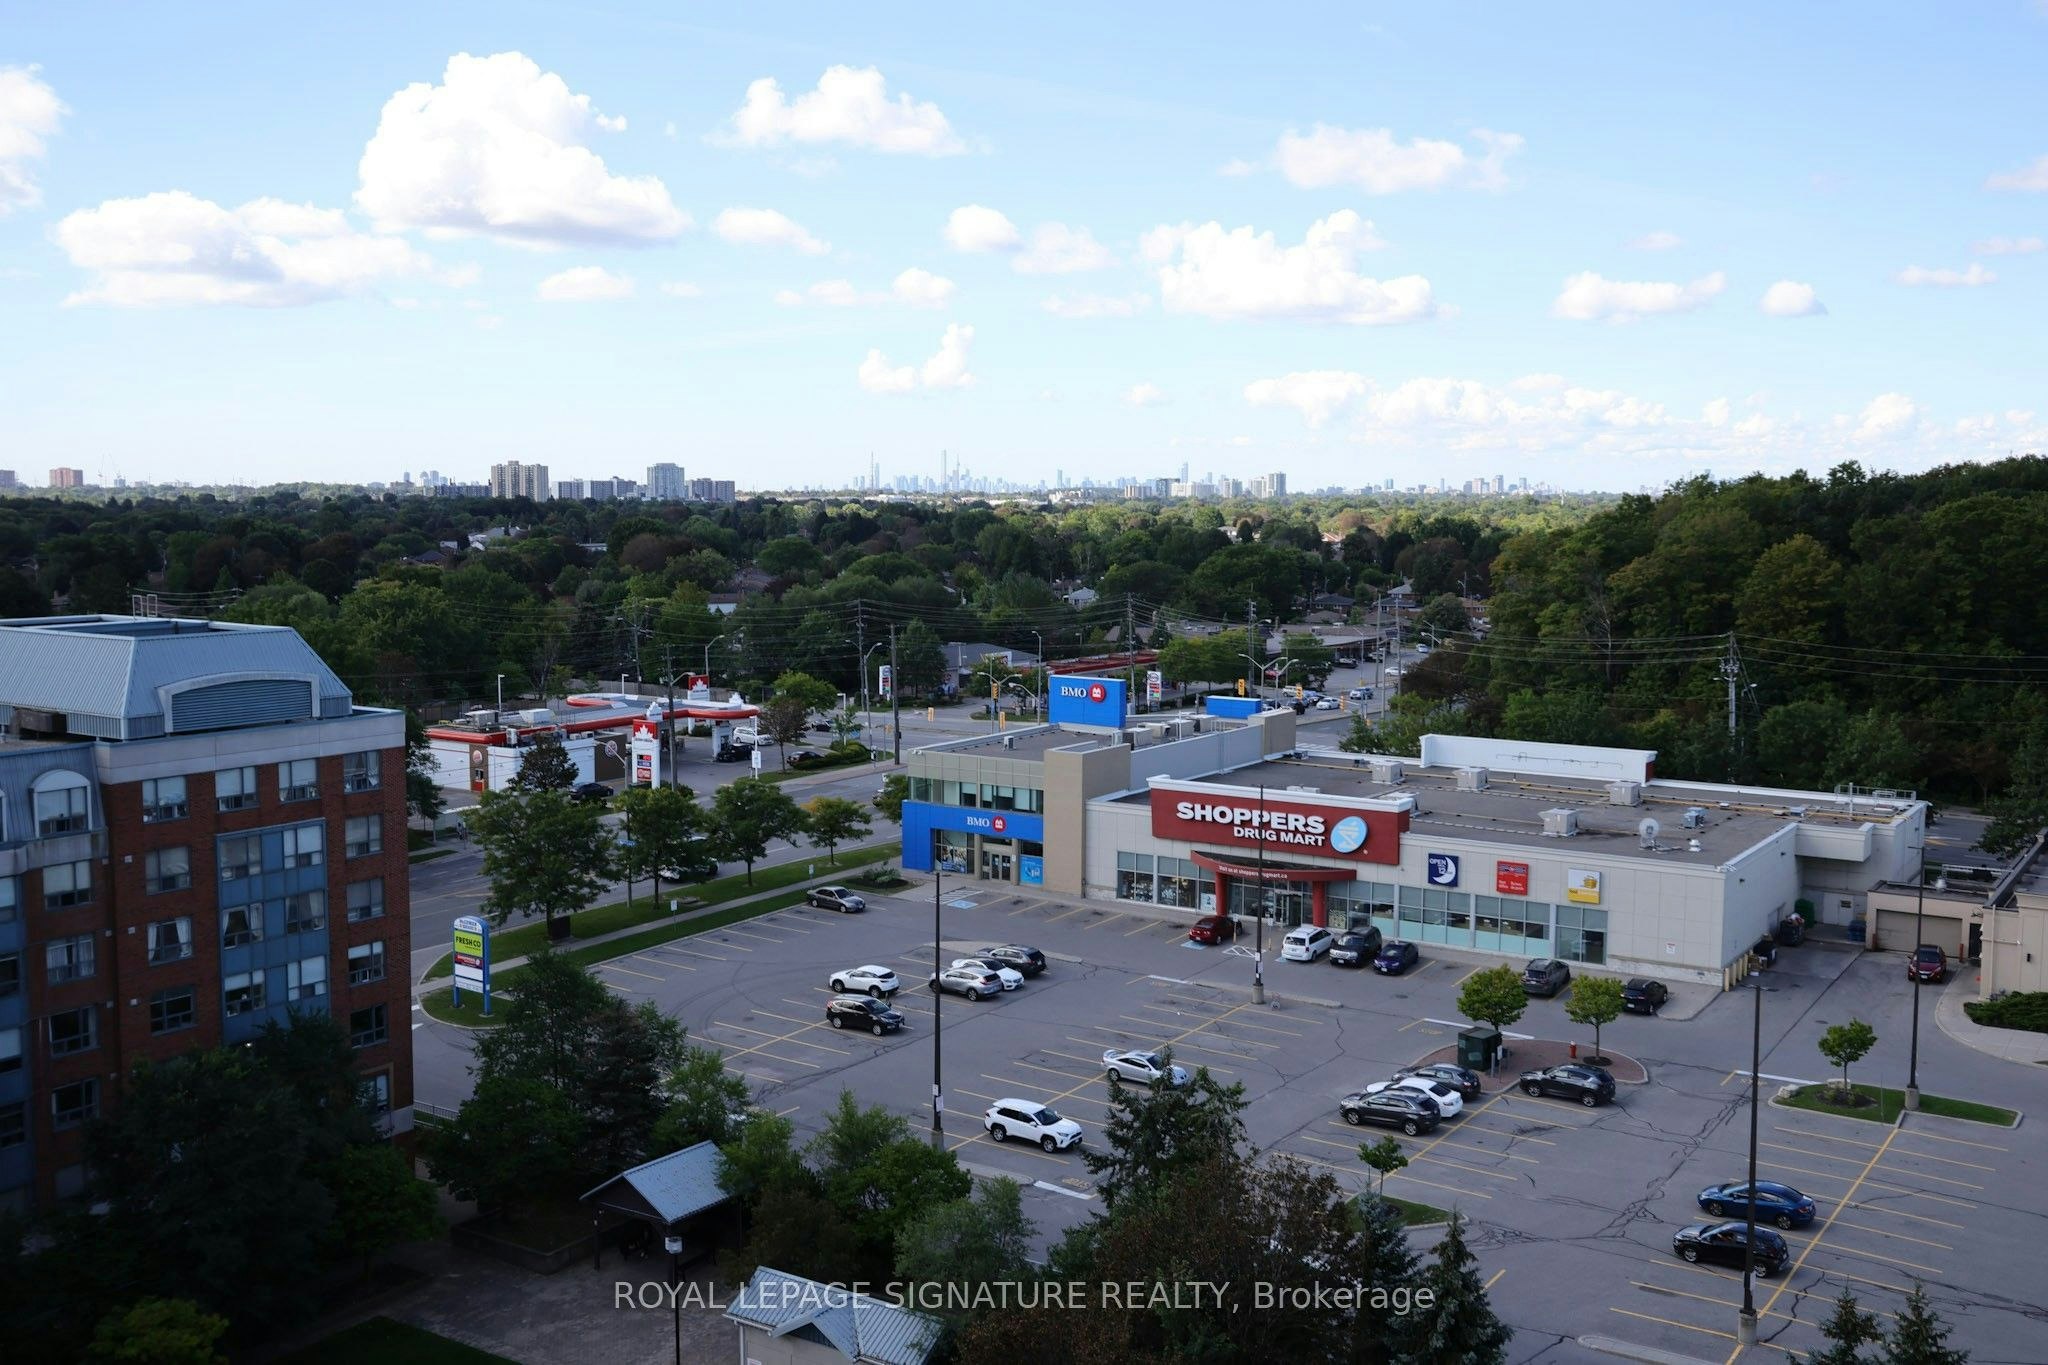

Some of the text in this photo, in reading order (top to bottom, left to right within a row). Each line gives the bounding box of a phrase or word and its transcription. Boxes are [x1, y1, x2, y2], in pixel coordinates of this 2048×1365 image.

[1061, 686, 1087, 698] BMO
[967, 816, 990, 827] BMO
[1176, 802, 1326, 835] SHOPPERS
[1233, 826, 1326, 847] DRUG MART
